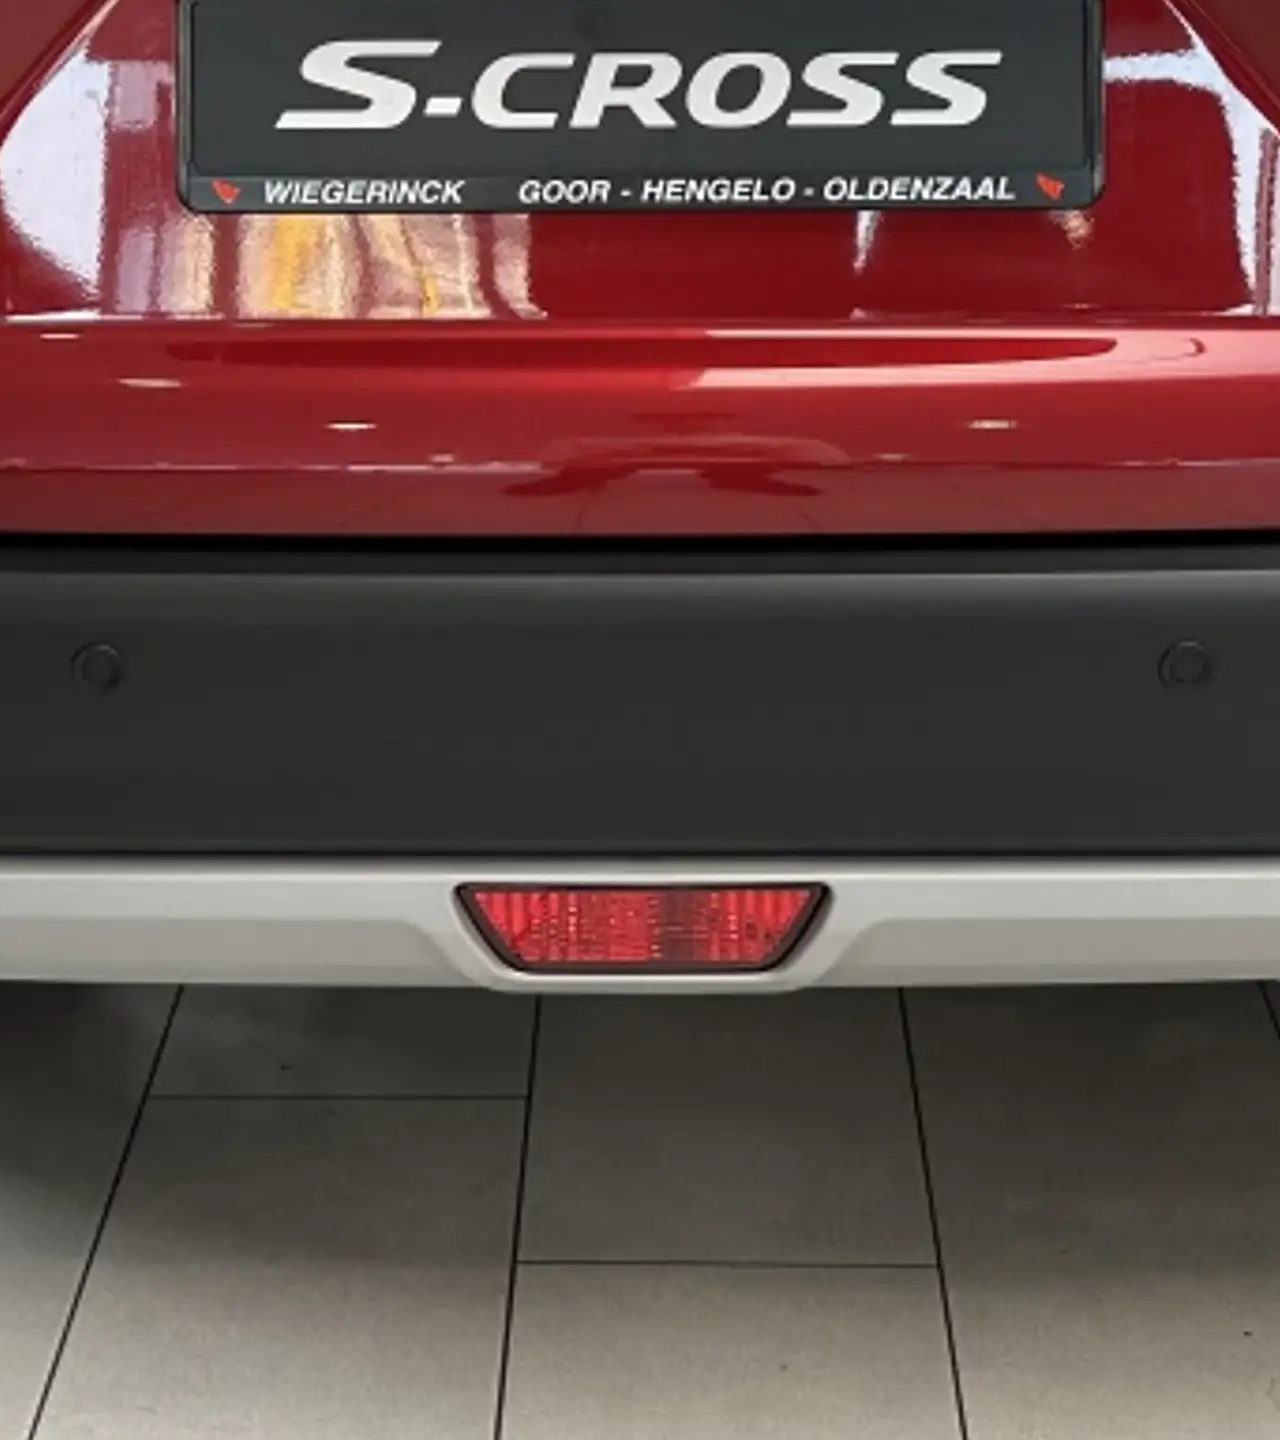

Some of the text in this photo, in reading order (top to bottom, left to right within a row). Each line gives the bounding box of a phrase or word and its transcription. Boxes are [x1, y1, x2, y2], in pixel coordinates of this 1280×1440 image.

[274, 38, 1004, 129] S-CROSS
[263, 179, 466, 205] WIEGERINCK
[519, 179, 611, 204] GOOR
[641, 177, 796, 202] HENGELO
[822, 176, 1017, 201] OLDENZAAL
